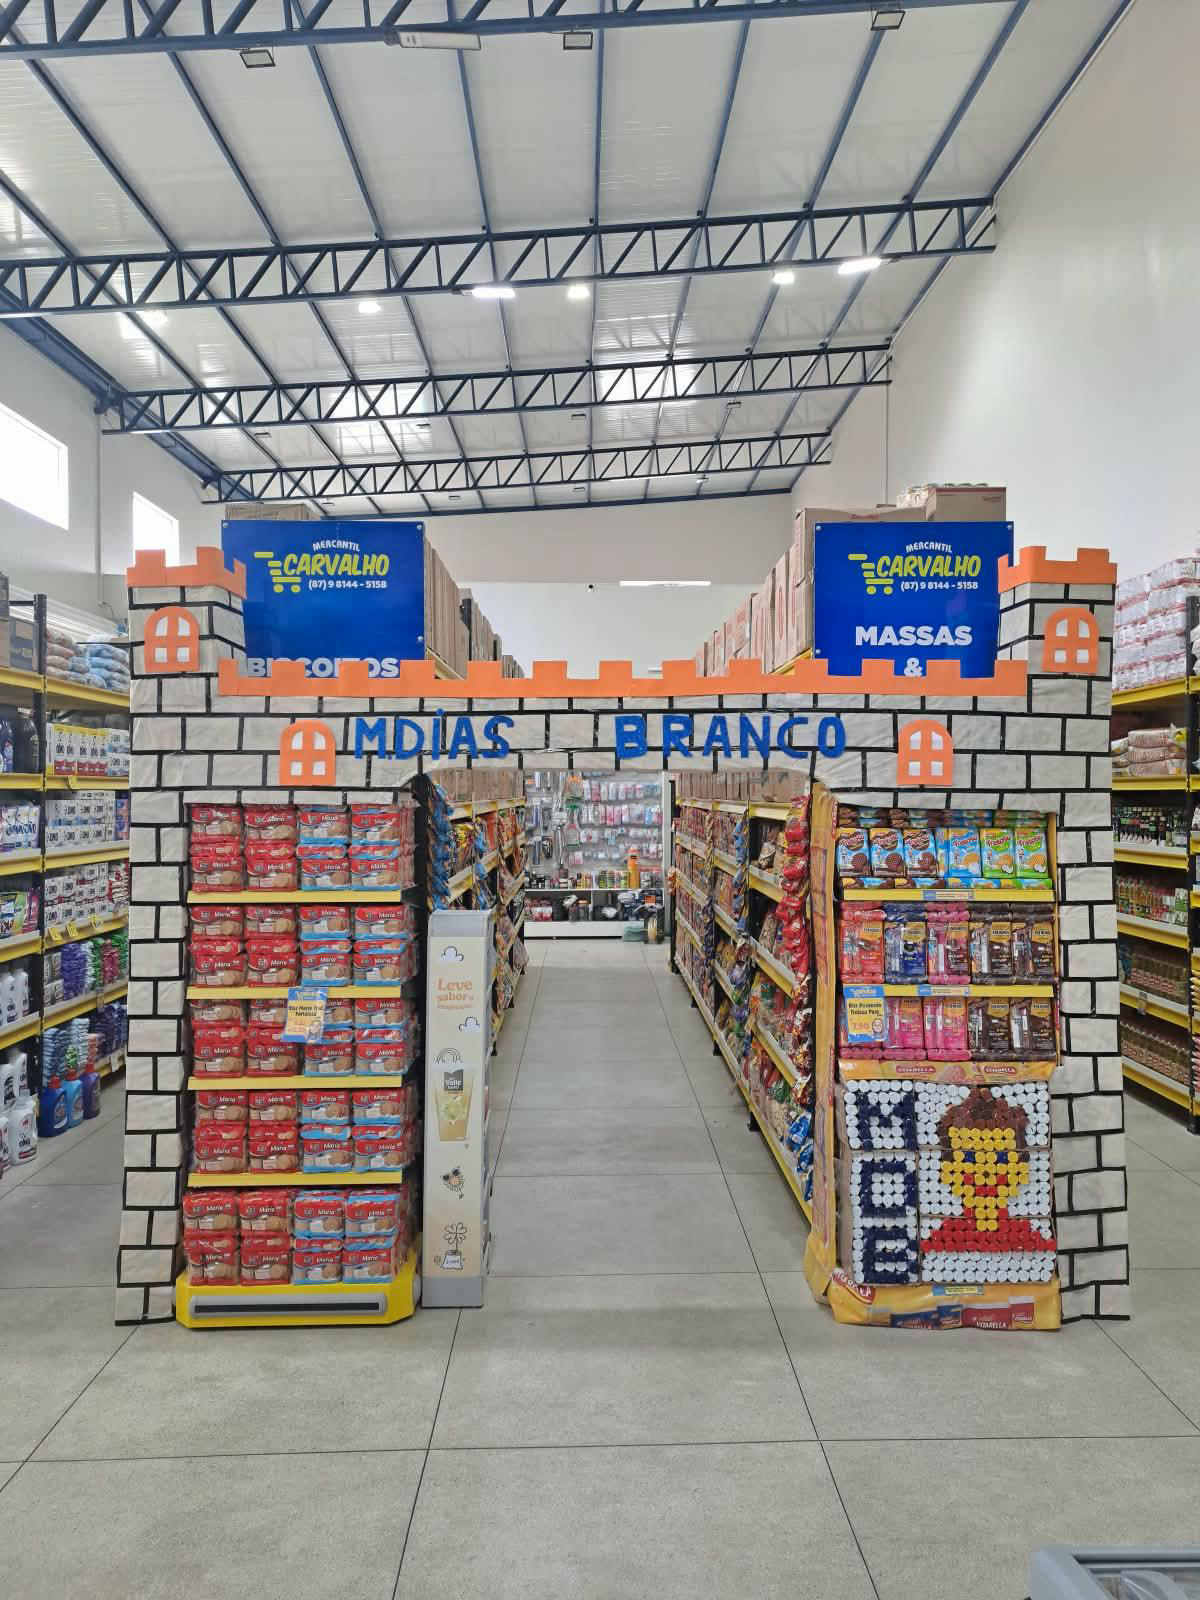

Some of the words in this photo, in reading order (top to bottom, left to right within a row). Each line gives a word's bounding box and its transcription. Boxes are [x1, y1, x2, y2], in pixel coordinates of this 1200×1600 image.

[312, 539, 361, 552] MERCANTIL
[905, 541, 953, 553] MERCANTIL
[283, 552, 390, 577] CARVALHO
[877, 554, 982, 577] CARVALHO
[308, 579, 327, 591] (87)
[328, 580, 334, 589] 9
[335, 580, 358, 589] 8144
[366, 580, 388, 589] 5158
[901, 580, 919, 592] (87)
[920, 581, 926, 589] 9
[927, 581, 950, 589] 8144
[957, 581, 978, 589] 5158
[855, 625, 974, 646] MASSAS
[903, 657, 924, 677] &
[614, 713, 848, 760] BRANCO
